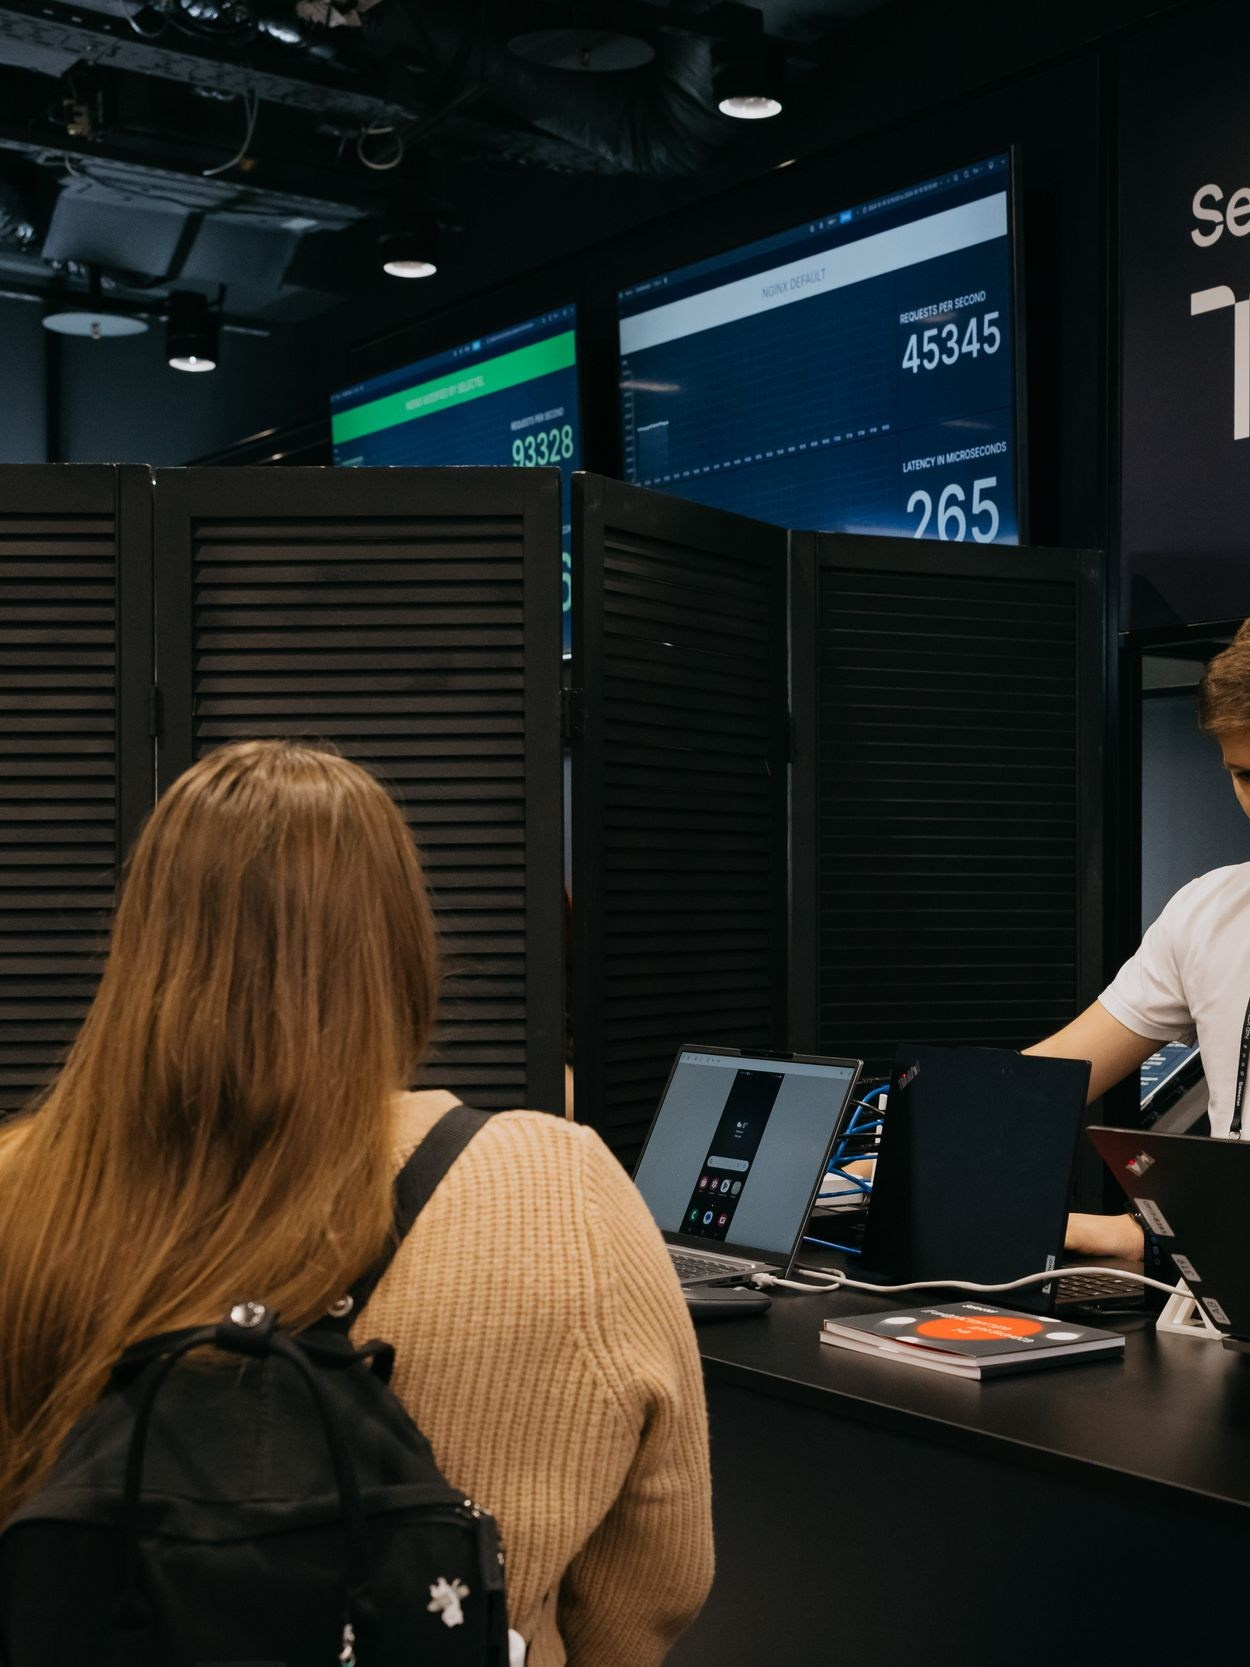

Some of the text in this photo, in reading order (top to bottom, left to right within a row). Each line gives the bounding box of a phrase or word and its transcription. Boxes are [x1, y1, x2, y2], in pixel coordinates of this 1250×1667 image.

[761, 268, 827, 299] NGINX DEFAULT
[900, 290, 987, 324] REQUESTS PER SECOND
[902, 310, 1001, 374] 45345
[512, 424, 574, 467] 93328
[903, 441, 1007, 473] LATENCY IN MICROSECONDS
[906, 476, 999, 544] 265
